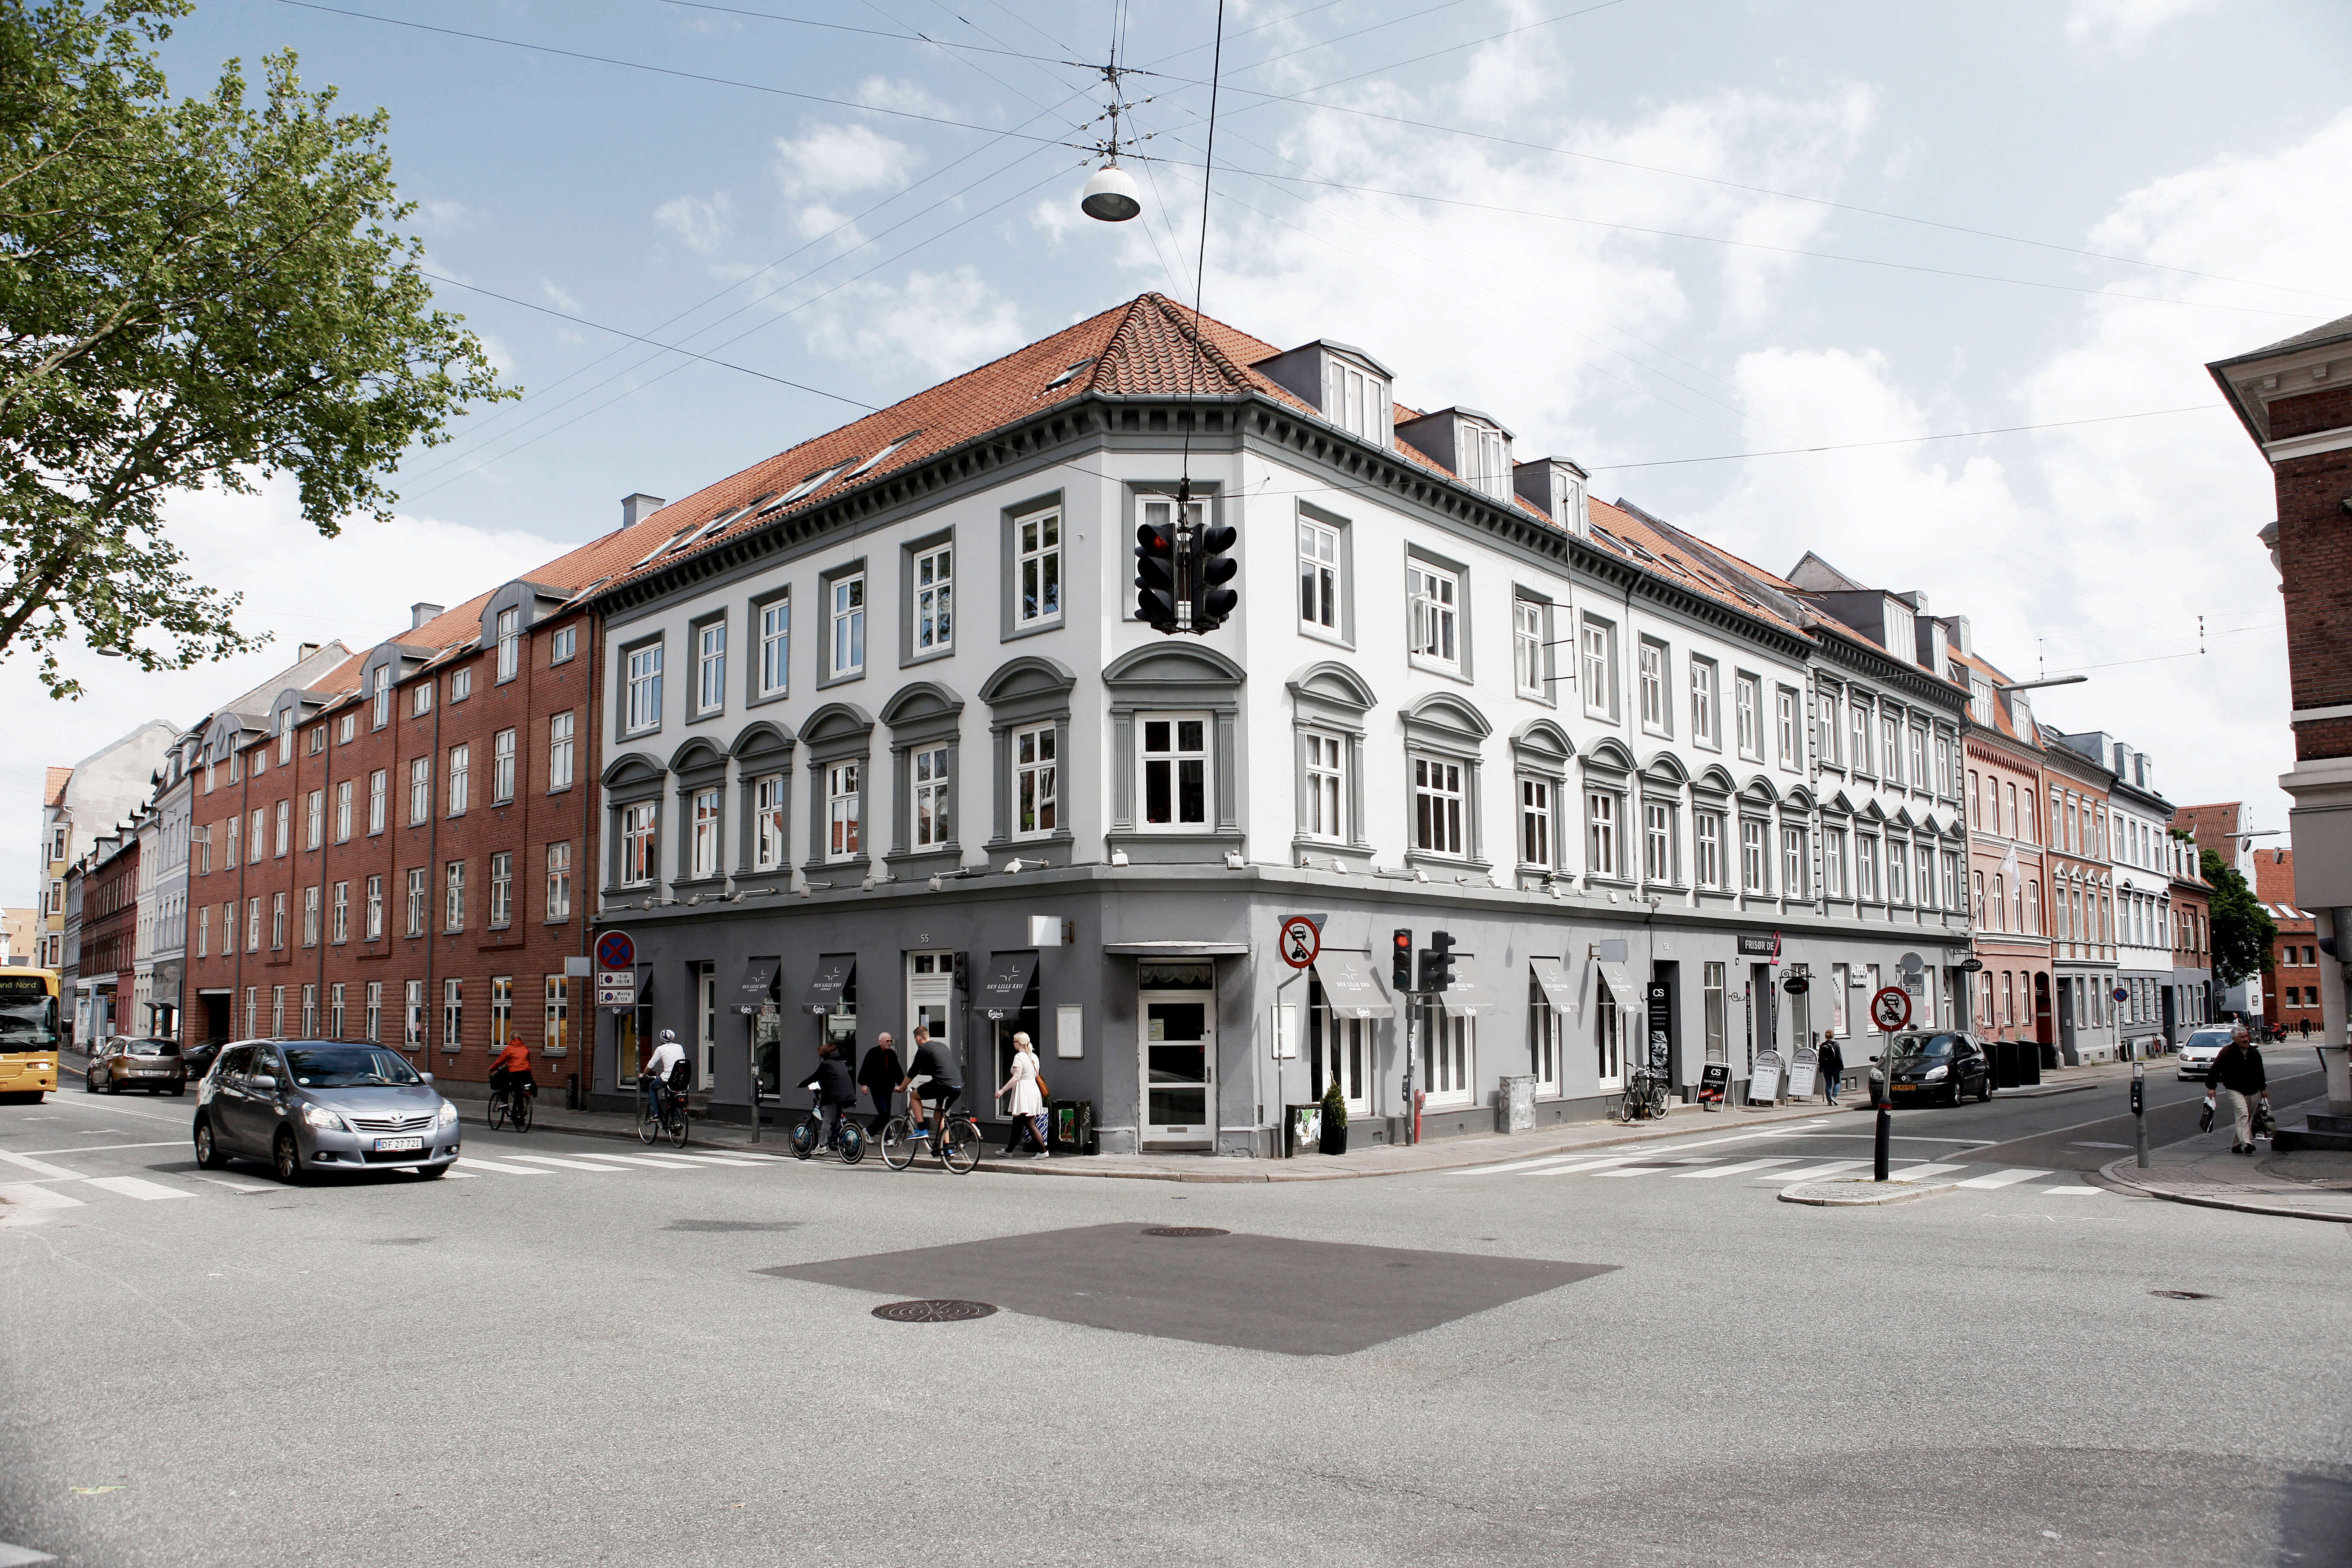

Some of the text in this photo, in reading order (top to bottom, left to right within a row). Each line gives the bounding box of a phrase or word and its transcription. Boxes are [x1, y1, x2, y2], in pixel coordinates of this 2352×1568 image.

[921, 934, 929, 942] 55
[1745, 930, 1782, 965] FRISØR DE 2
[1851, 964, 1868, 975] ALTHEA
[1653, 988, 1664, 997] CS
